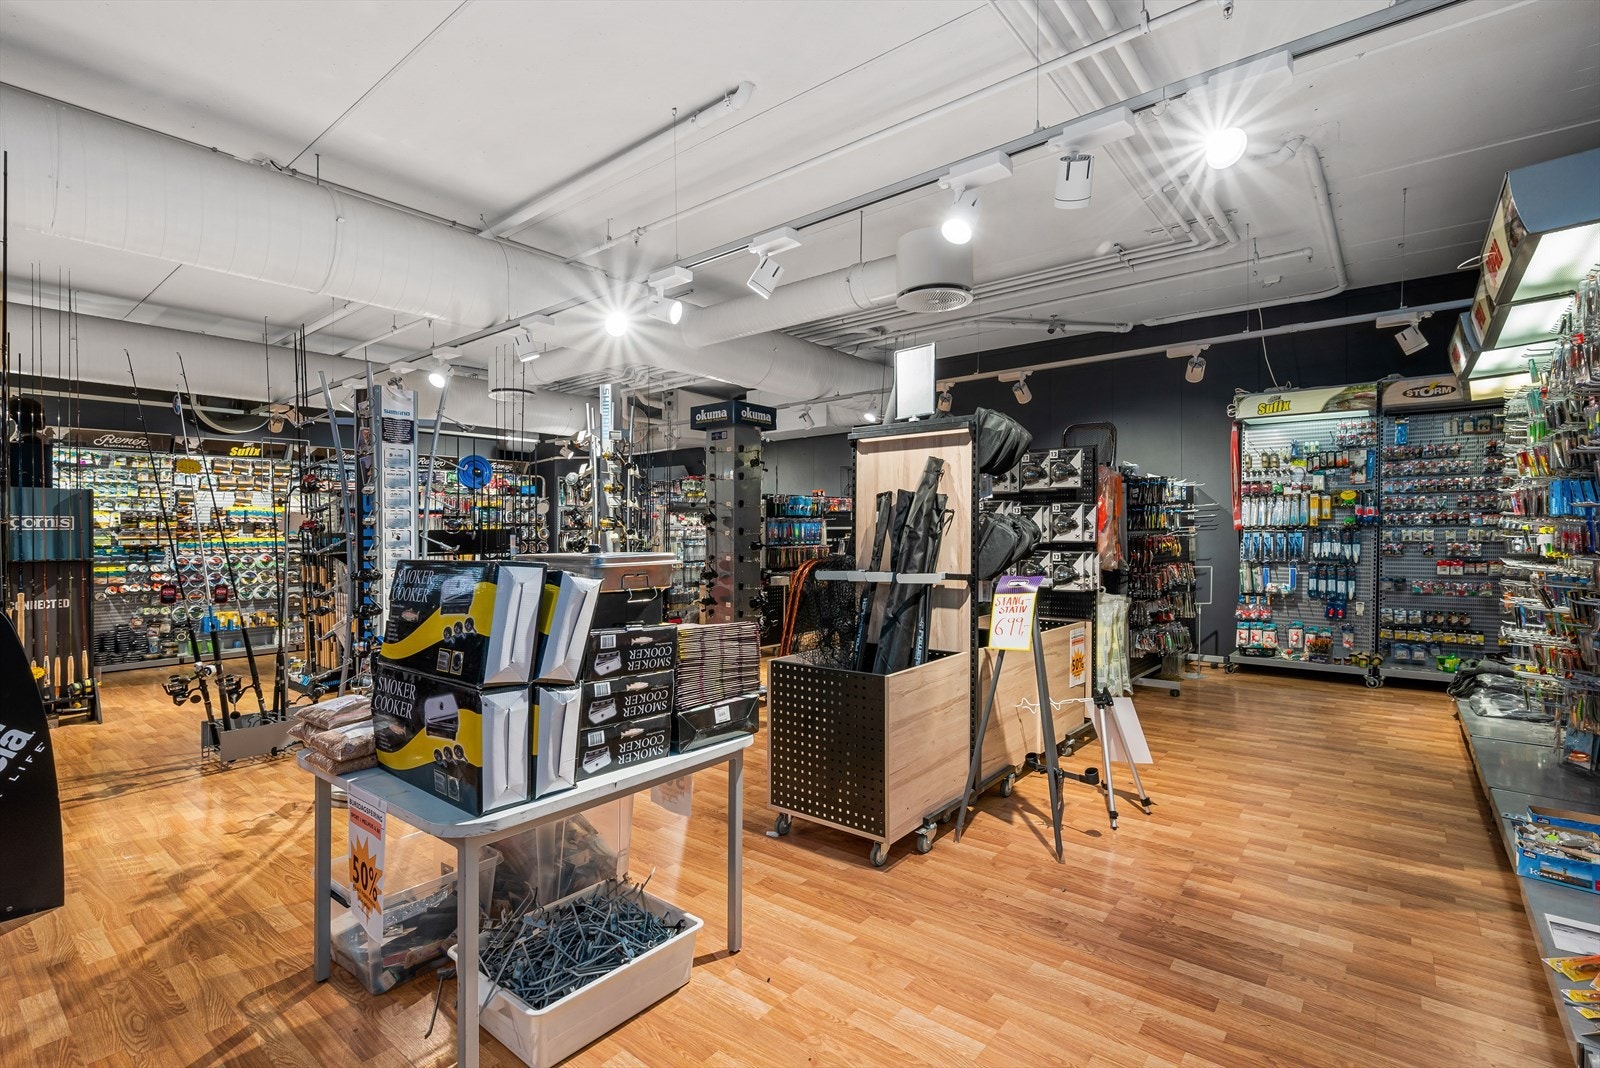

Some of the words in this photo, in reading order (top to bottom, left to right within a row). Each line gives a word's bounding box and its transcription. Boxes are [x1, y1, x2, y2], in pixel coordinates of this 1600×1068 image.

[1406, 386, 1452, 397] STORM
[383, 408, 410, 416] SHIMANO
[741, 407, 772, 421] okuma
[1258, 400, 1291, 415] Sufix
[696, 409, 727, 421] okuma
[229, 446, 261, 456] Sufix
[398, 570, 434, 585] SMOKER
[392, 586, 429, 602] COOKER
[10, 599, 70, 610] CNNECTED
[999, 605, 1027, 614] STATIV
[628, 646, 672, 660] COOKER
[627, 657, 671, 671] SMOKER
[1072, 657, 1084, 671] 50%
[378, 676, 416, 701] SMOKER
[624, 691, 668, 706] COOKER
[374, 695, 412, 719] COOKER
[623, 700, 667, 718] SMOKER
[618, 734, 665, 753] COOKER
[617, 744, 664, 765] SMOKER
[353, 855, 377, 901] 50%
